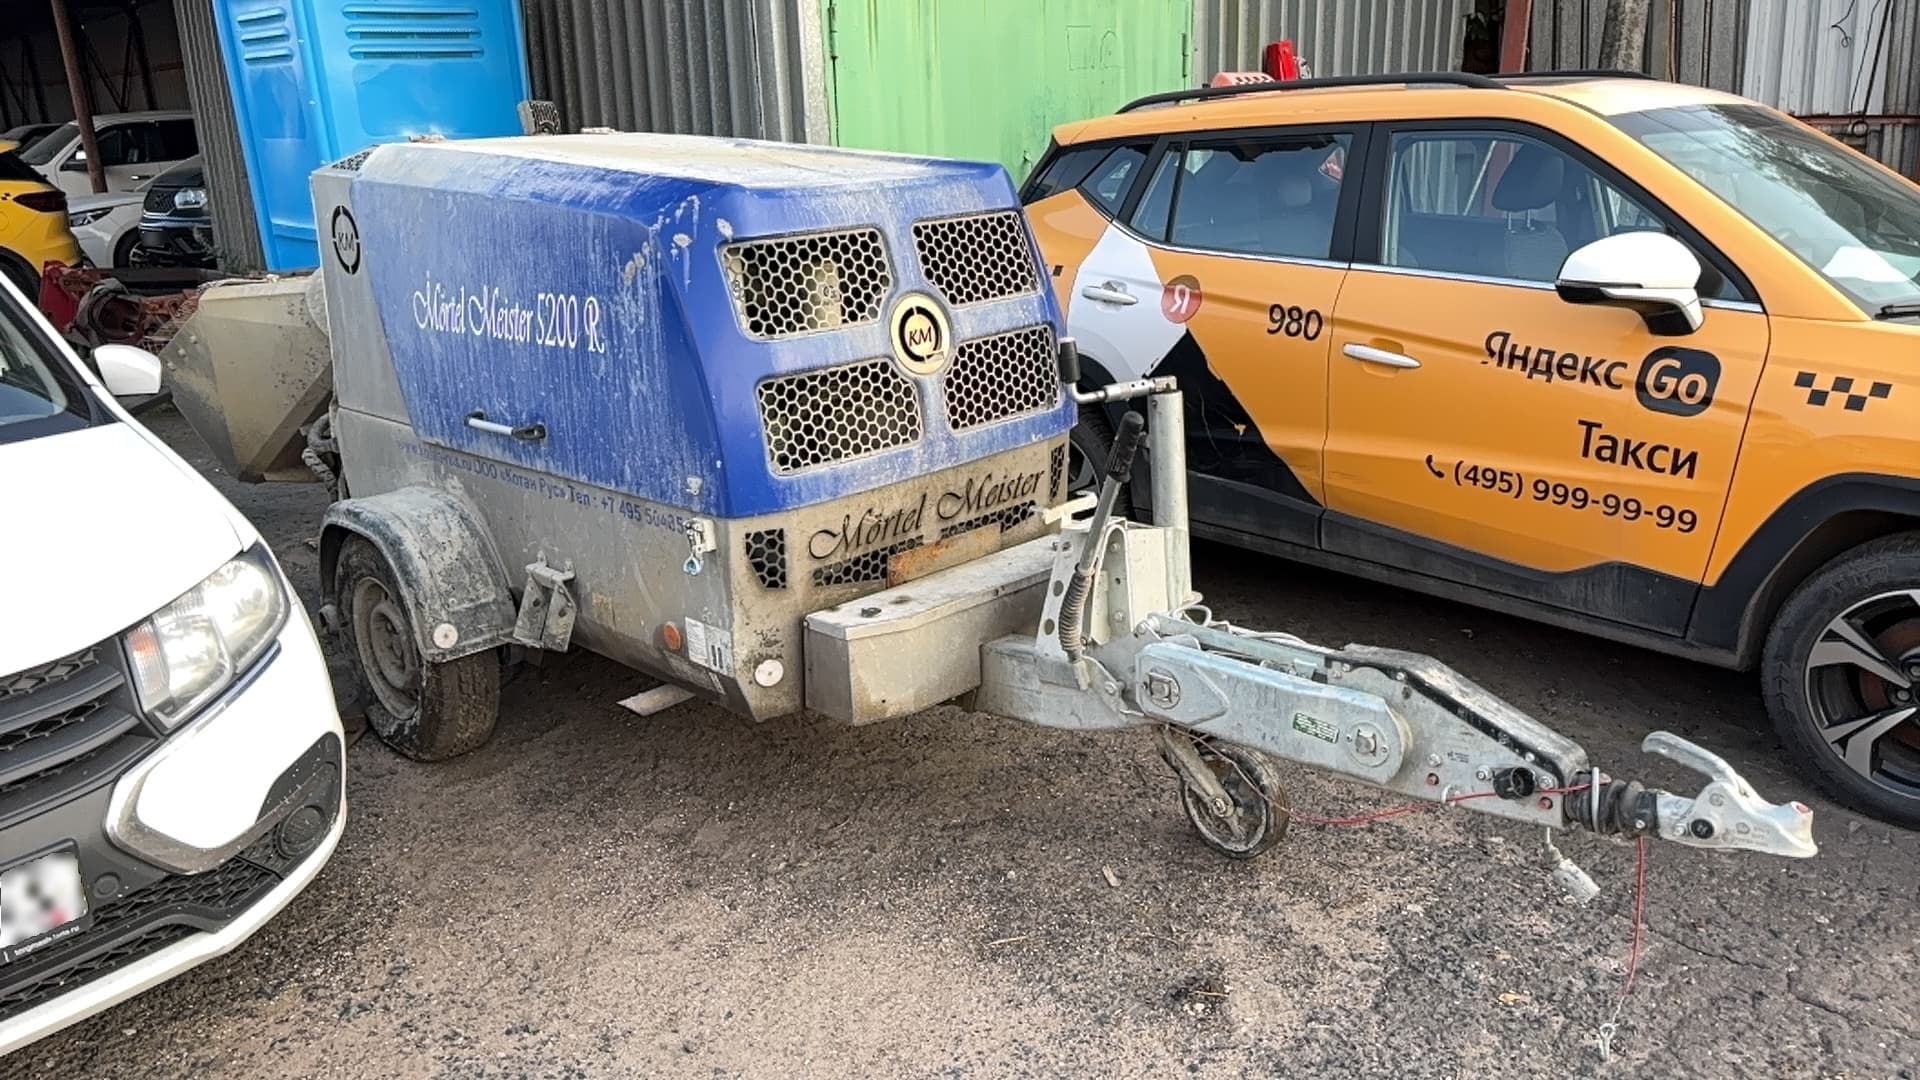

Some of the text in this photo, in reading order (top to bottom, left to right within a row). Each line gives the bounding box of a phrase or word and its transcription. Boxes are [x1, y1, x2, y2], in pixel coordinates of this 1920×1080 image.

[468, 284, 534, 342] Meister
[536, 292, 578, 349] 5200
[584, 296, 605, 353] R
[1170, 284, 1191, 314] Я
[1267, 303, 1323, 341] 980
[908, 325, 933, 347] KM
[1481, 331, 1709, 406] Яндекс Go
[1578, 419, 1699, 480] Такси
[601, 496, 614, 513] +7
[620, 500, 642, 522] 495
[936, 470, 1045, 521] Meister
[1454, 460, 1698, 534] (495) 999-99-99
